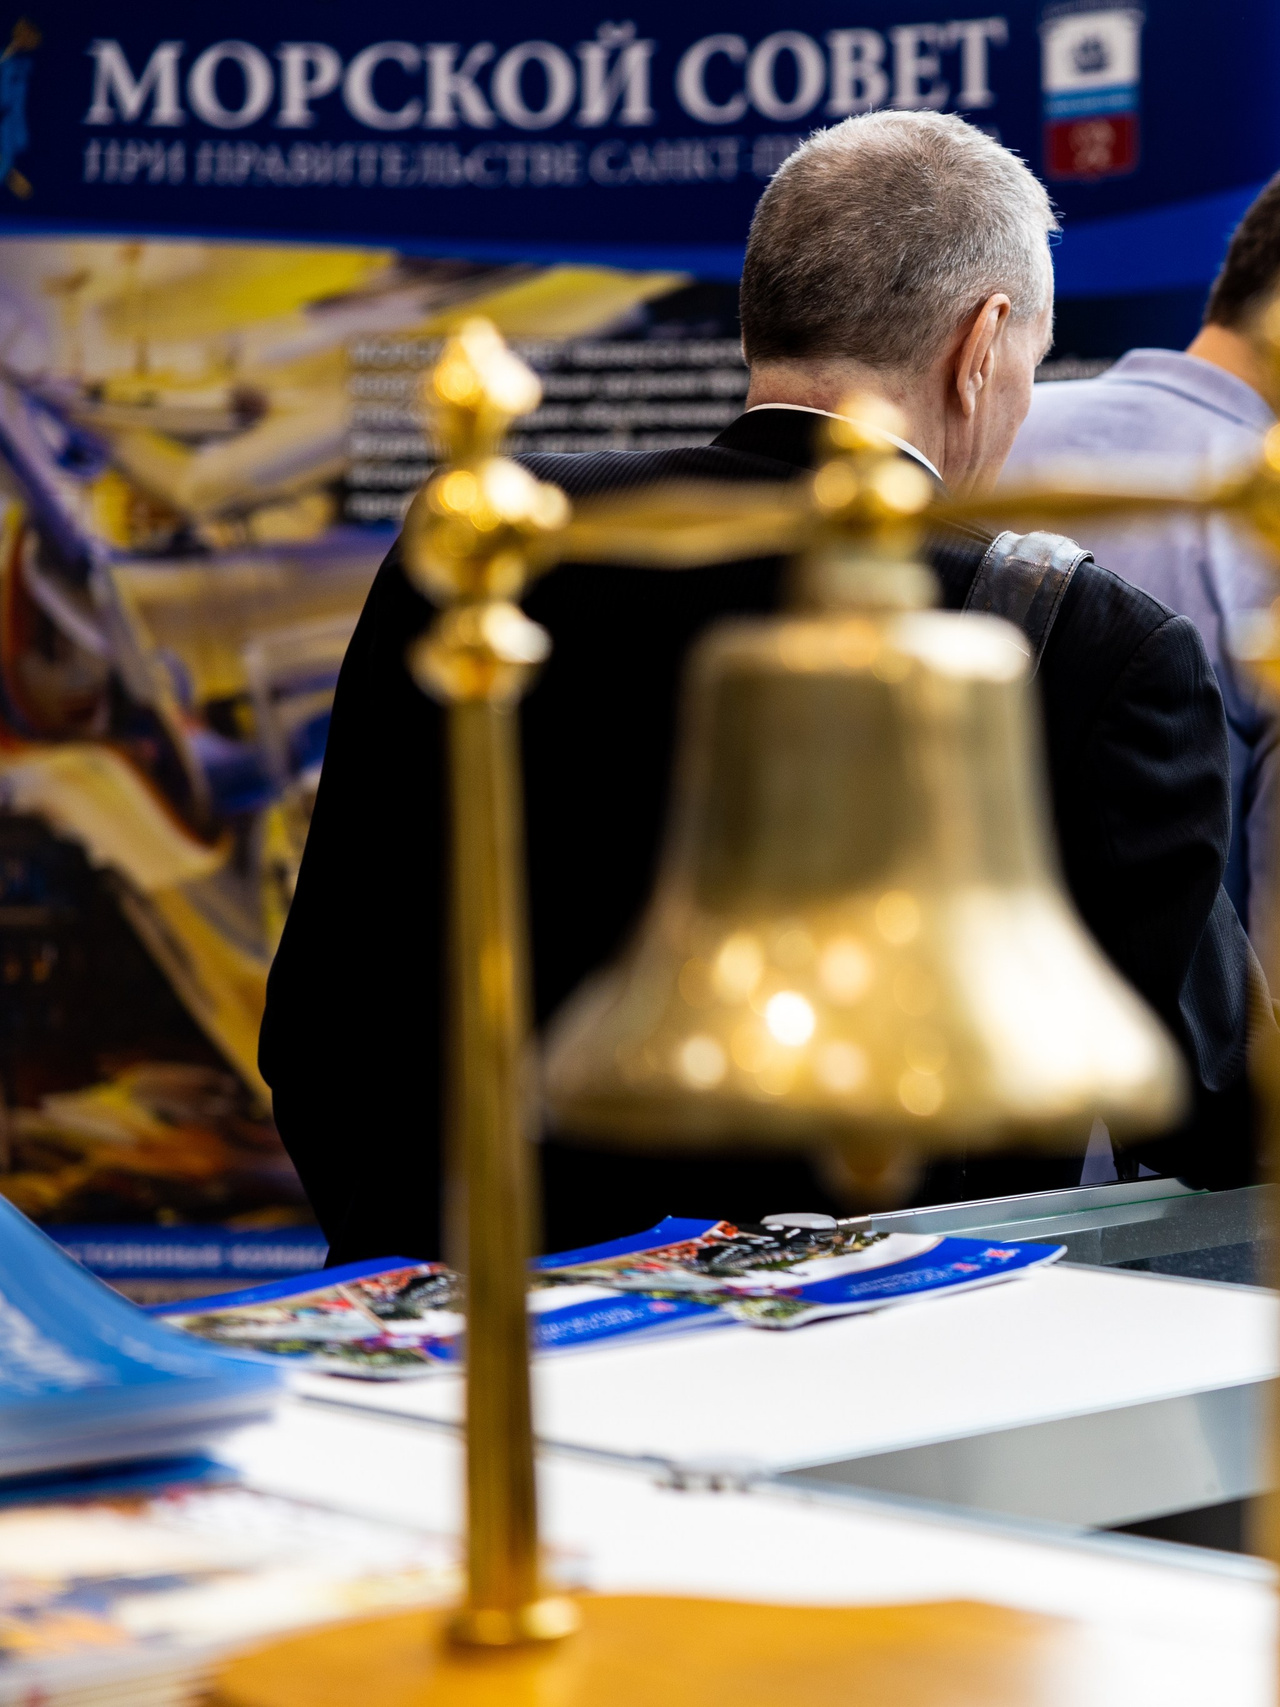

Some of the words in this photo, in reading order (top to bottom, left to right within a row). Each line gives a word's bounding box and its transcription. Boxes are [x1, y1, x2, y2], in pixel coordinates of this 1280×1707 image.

[82, 20, 656, 130] МОРСКОЙ
[674, 16, 1007, 125] СОВЕТ
[83, 137, 187, 186] ПРИ
